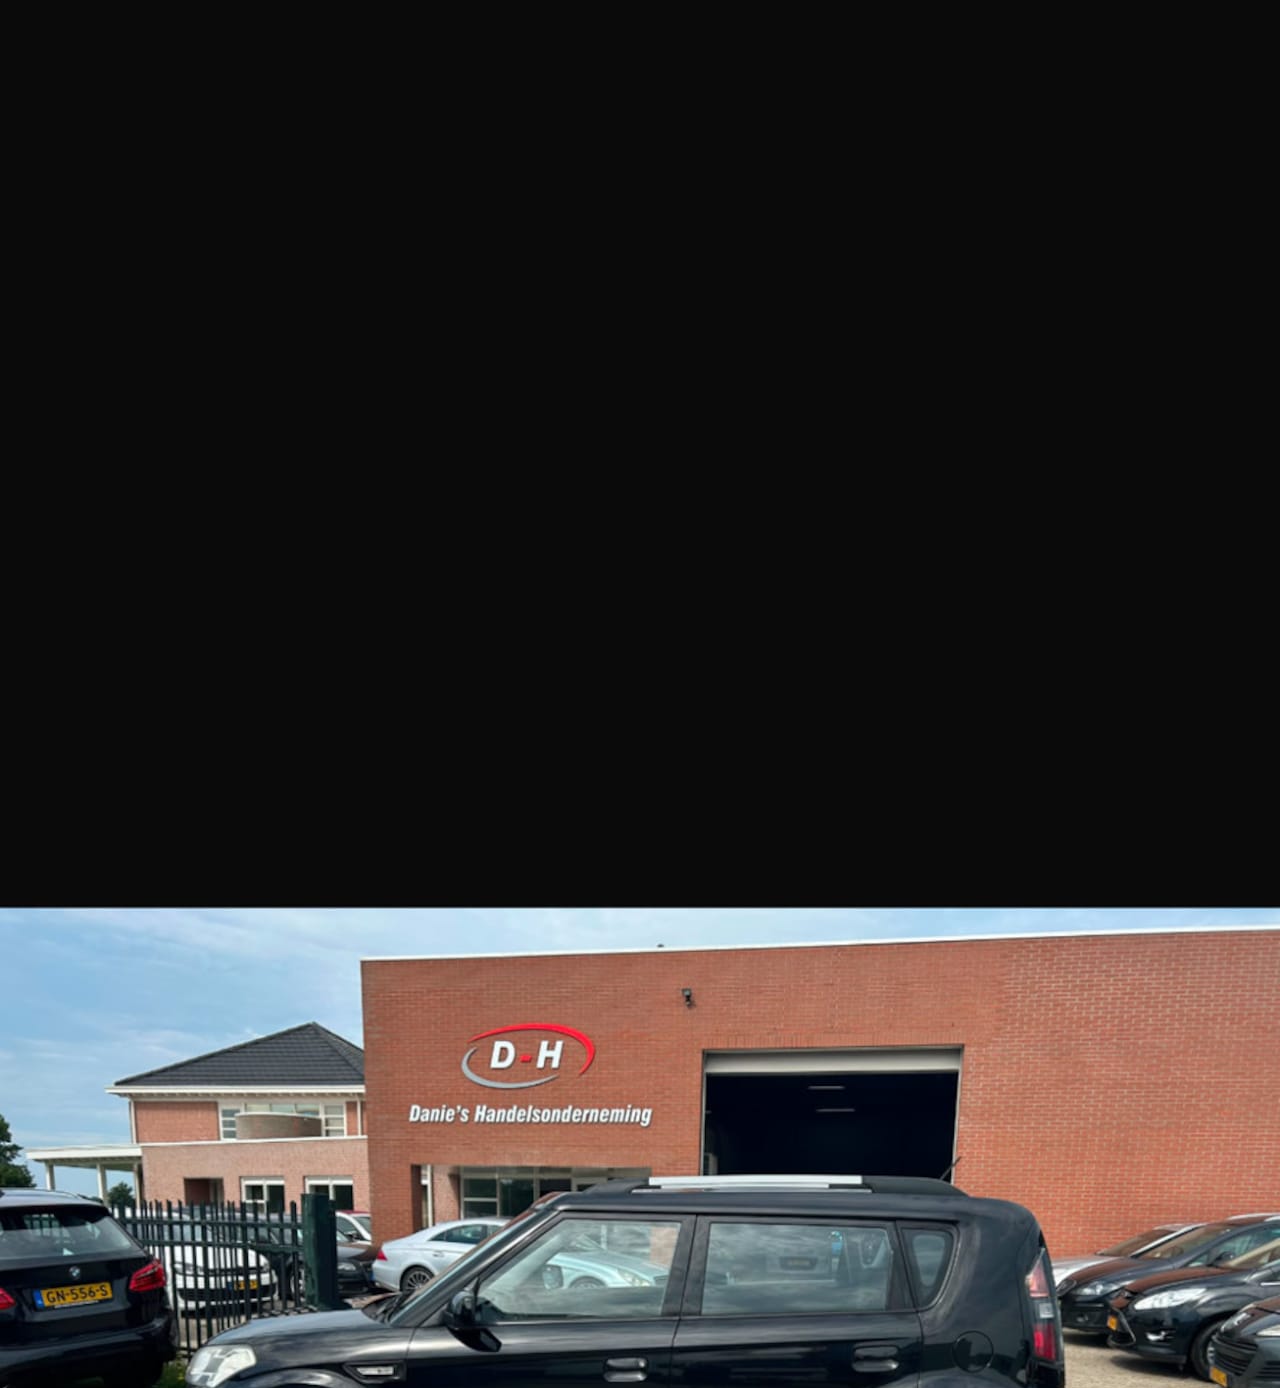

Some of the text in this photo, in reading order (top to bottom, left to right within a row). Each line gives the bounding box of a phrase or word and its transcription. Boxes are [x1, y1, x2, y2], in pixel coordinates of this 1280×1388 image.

[409, 1104, 652, 1127] Danie's Handelsonderneming
[46, 1284, 108, 1303] GN-556-S
